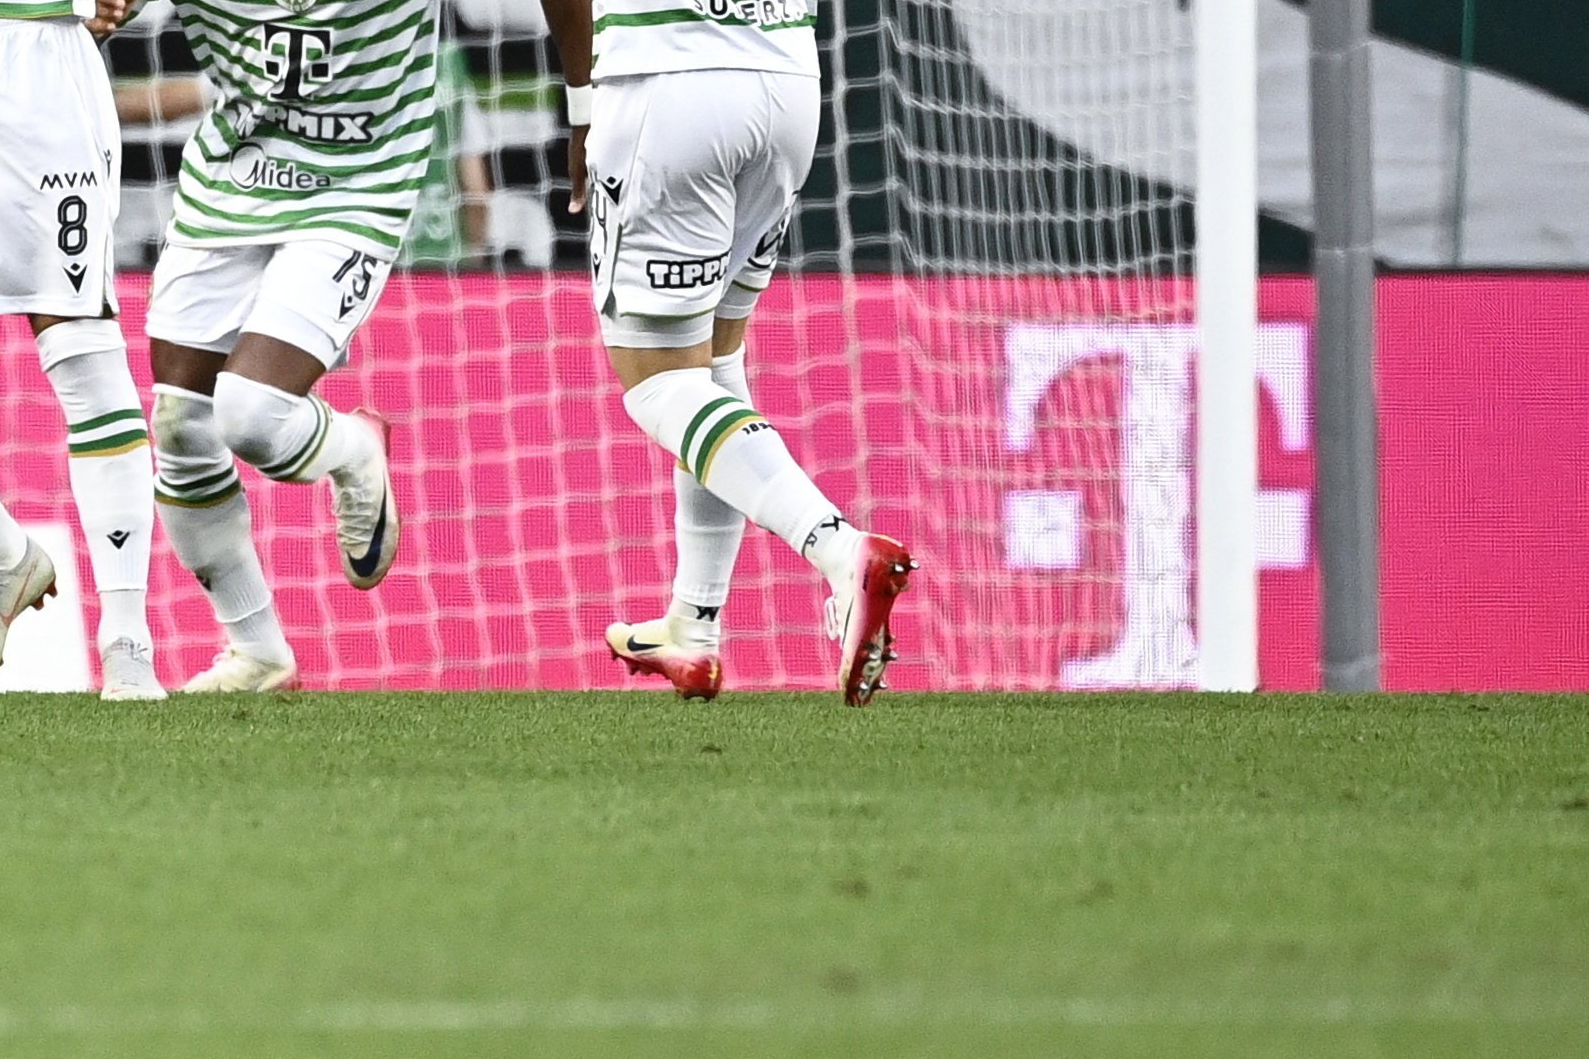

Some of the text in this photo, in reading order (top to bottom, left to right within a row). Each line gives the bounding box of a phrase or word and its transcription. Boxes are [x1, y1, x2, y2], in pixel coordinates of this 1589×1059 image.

[39, 171, 98, 190] MVM
[236, 151, 331, 189] Midea
[58, 195, 88, 256] 8
